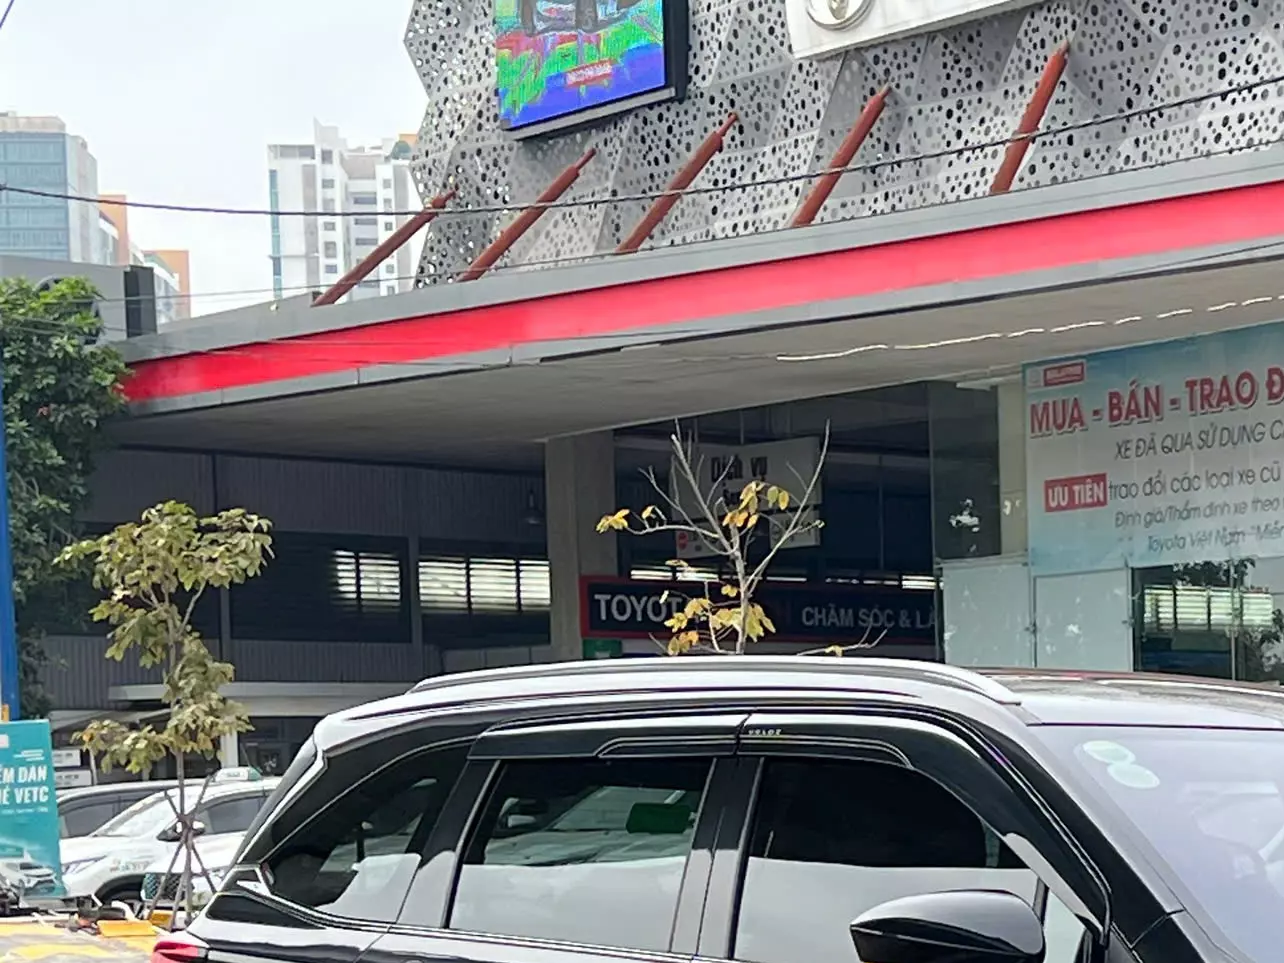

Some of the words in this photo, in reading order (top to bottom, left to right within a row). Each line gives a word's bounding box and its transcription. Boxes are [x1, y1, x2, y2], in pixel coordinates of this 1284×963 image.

[1030, 398, 1087, 437] MUA
[1108, 379, 1163, 427] BÁN
[1185, 371, 1259, 416] TRAO
[1115, 439, 1133, 460] XE
[1135, 432, 1157, 457] ĐÃ
[1161, 432, 1194, 455] QUA
[1197, 422, 1217, 450] SỬ
[1219, 421, 1266, 449] DỤNG
[1048, 482, 1069, 508] ƯU
[1074, 479, 1104, 505] TIÊN
[1109, 480, 1139, 500] trao
[1143, 469, 1167, 497] đổi
[1170, 471, 1201, 493] các
[1205, 465, 1234, 489] loại
[1238, 468, 1256, 486] xe
[1260, 463, 1281, 483] cũ
[1148, 531, 1186, 553] Toyota
[594, 594, 690, 622] TOYOT
[858, 604, 896, 628] SÓC
[14, 786, 49, 804] VETC
